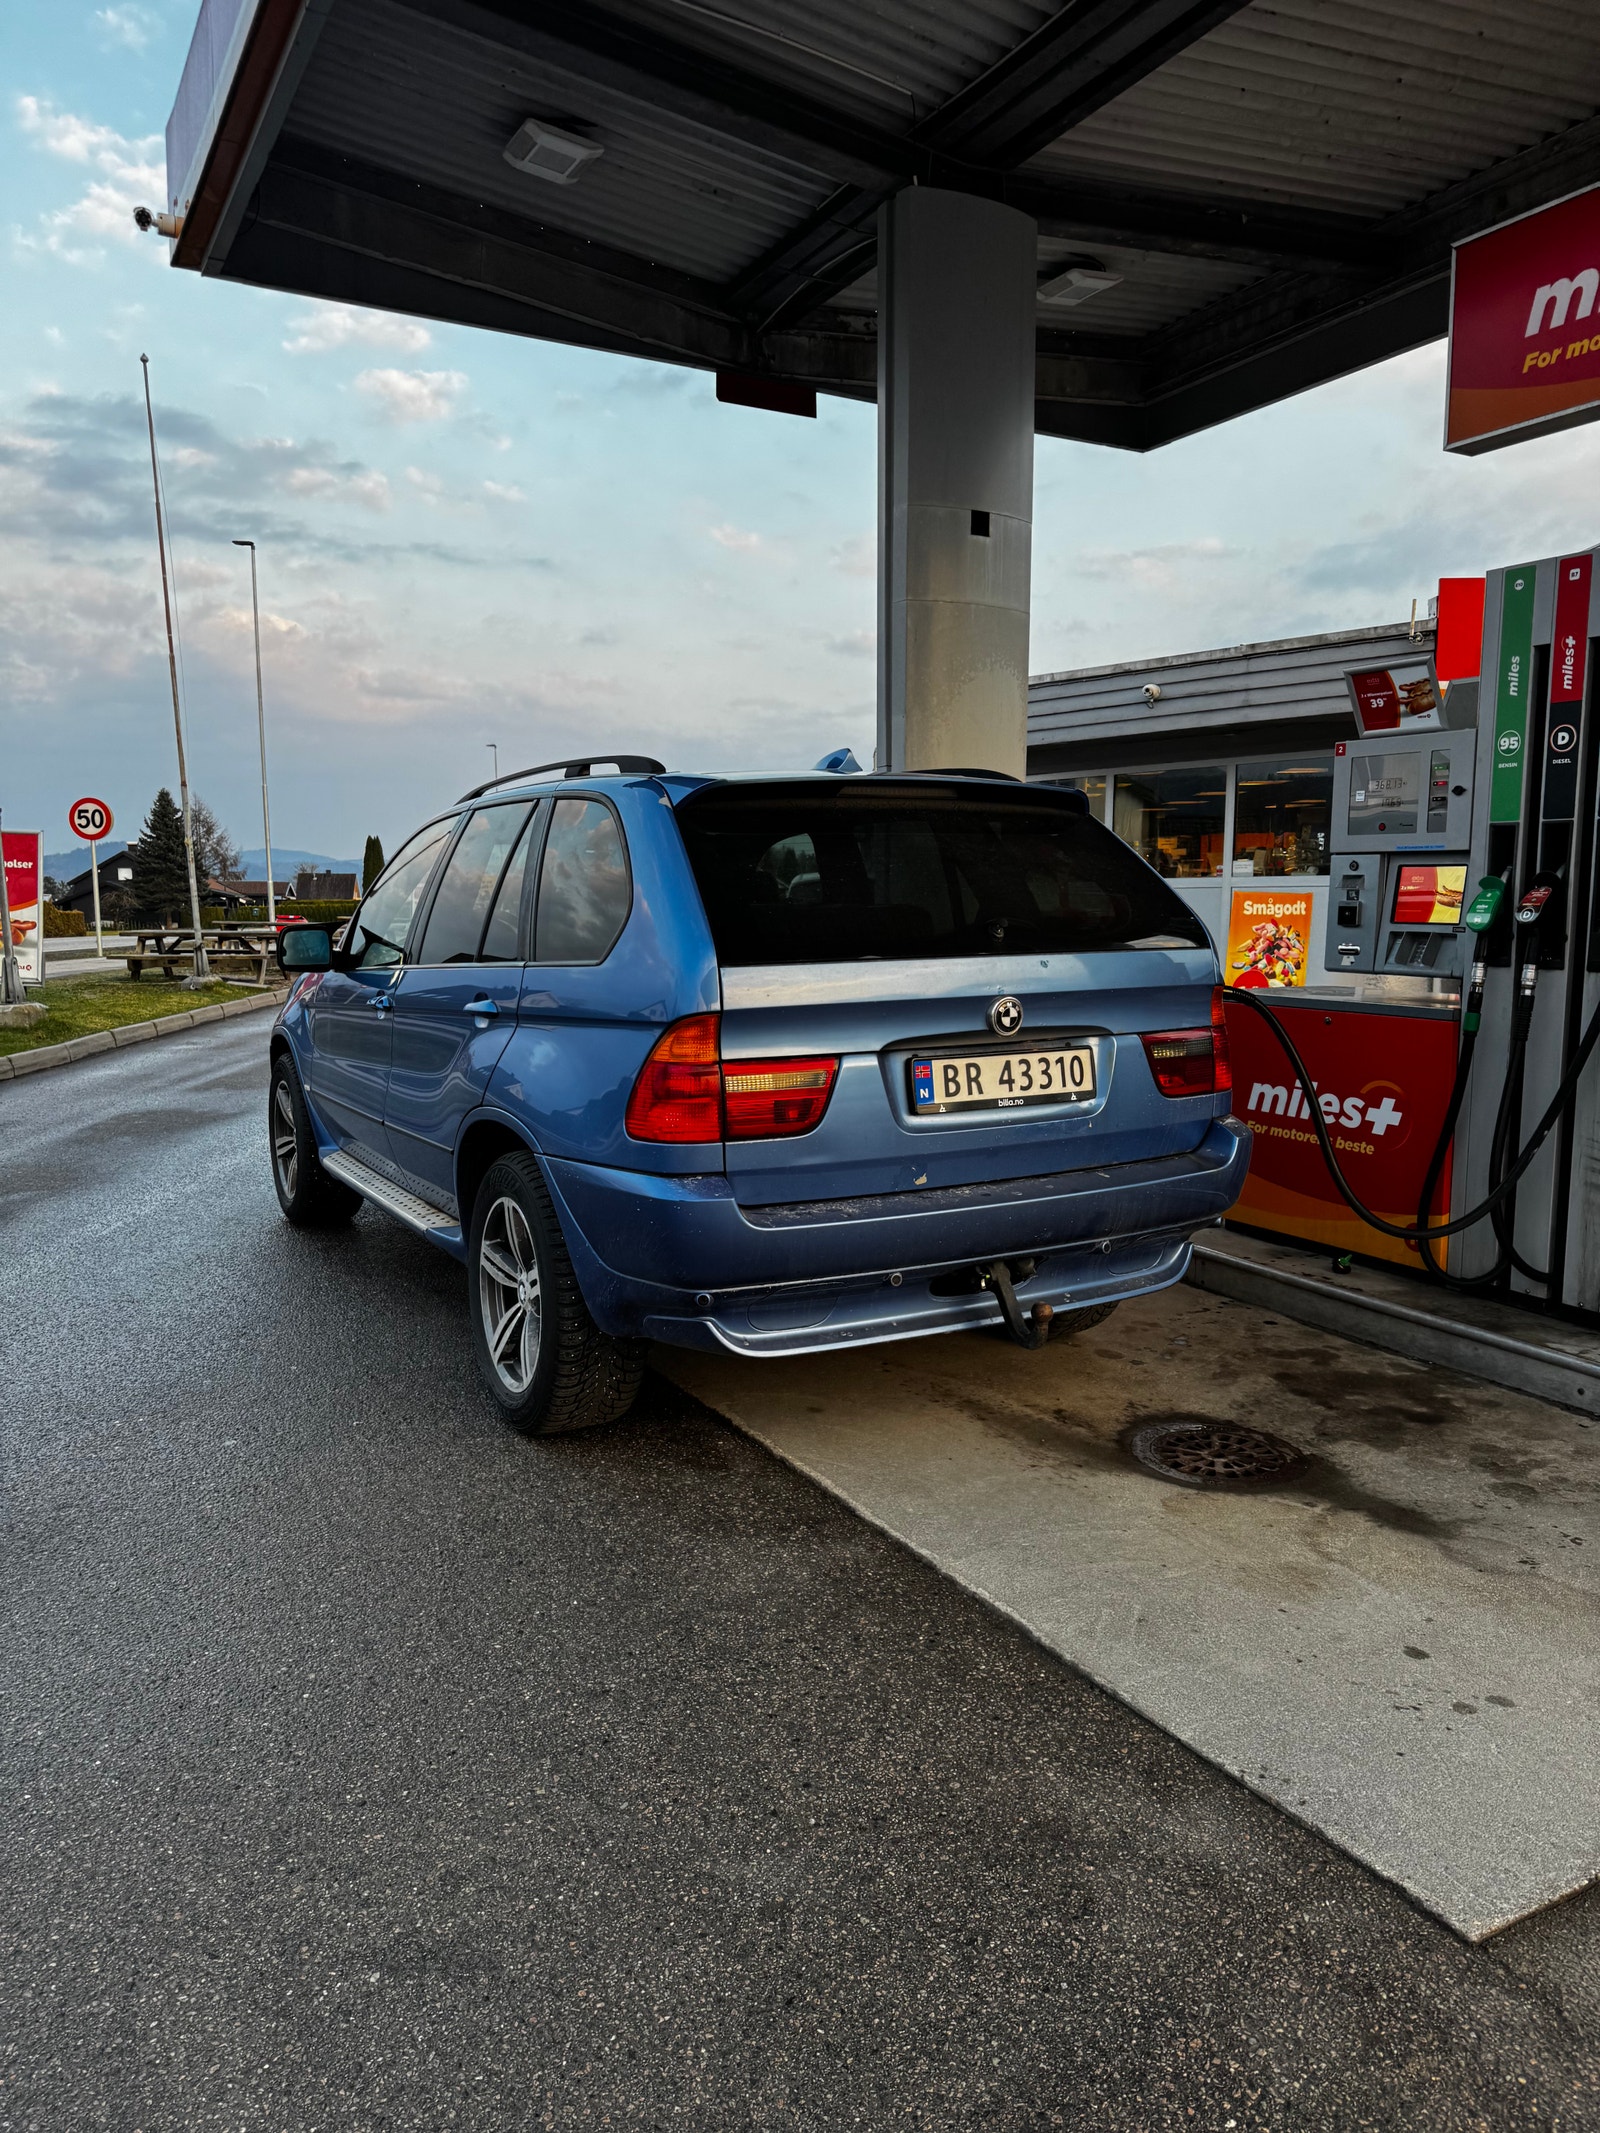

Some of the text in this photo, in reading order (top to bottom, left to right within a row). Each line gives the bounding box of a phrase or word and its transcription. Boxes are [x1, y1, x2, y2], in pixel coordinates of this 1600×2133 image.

[1522, 347, 1563, 374] For
[1508, 655, 1520, 696] miles
[1370, 698, 1384, 708] 39
[1500, 736, 1519, 750] 95
[1557, 731, 1570, 745] D
[77, 808, 104, 829] 50
[1243, 898, 1307, 918] Smågodt
[1523, 910, 1531, 919] D
[943, 1055, 1084, 1098] BR 43310
[920, 1088, 929, 1099] N
[1246, 1120, 1268, 1134] For
[1335, 1136, 1375, 1155] beste
